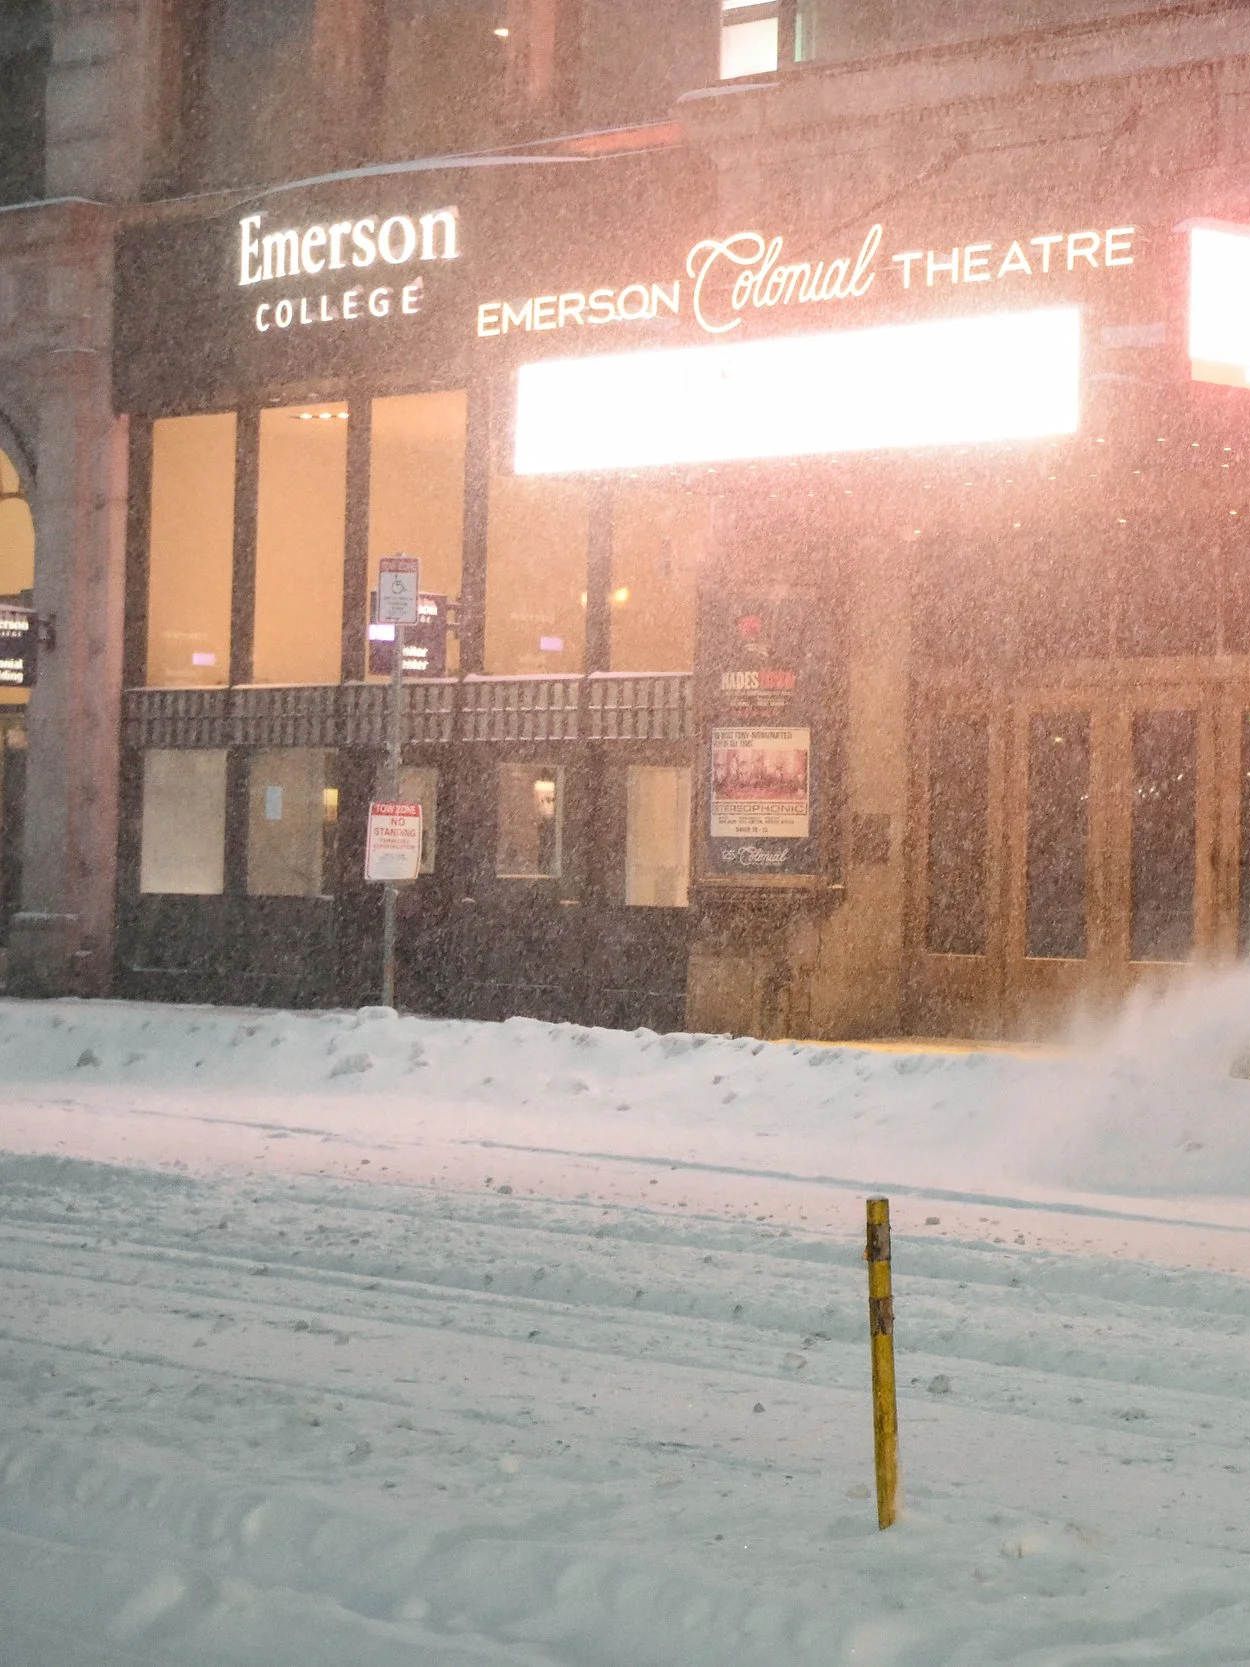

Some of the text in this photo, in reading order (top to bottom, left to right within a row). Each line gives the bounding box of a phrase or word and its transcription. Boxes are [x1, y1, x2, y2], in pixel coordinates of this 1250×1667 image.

[238, 210, 461, 286] Emerson
[477, 224, 1135, 337] EMERSON Colonial THEATRE
[255, 286, 422, 332] COLLEGE
[376, 803, 417, 814] TOW ZONE
[712, 804, 805, 813] STEREOPHONIC
[391, 817, 406, 827] NO
[374, 827, 416, 838] STANDING
[737, 846, 789, 866] Colonial
